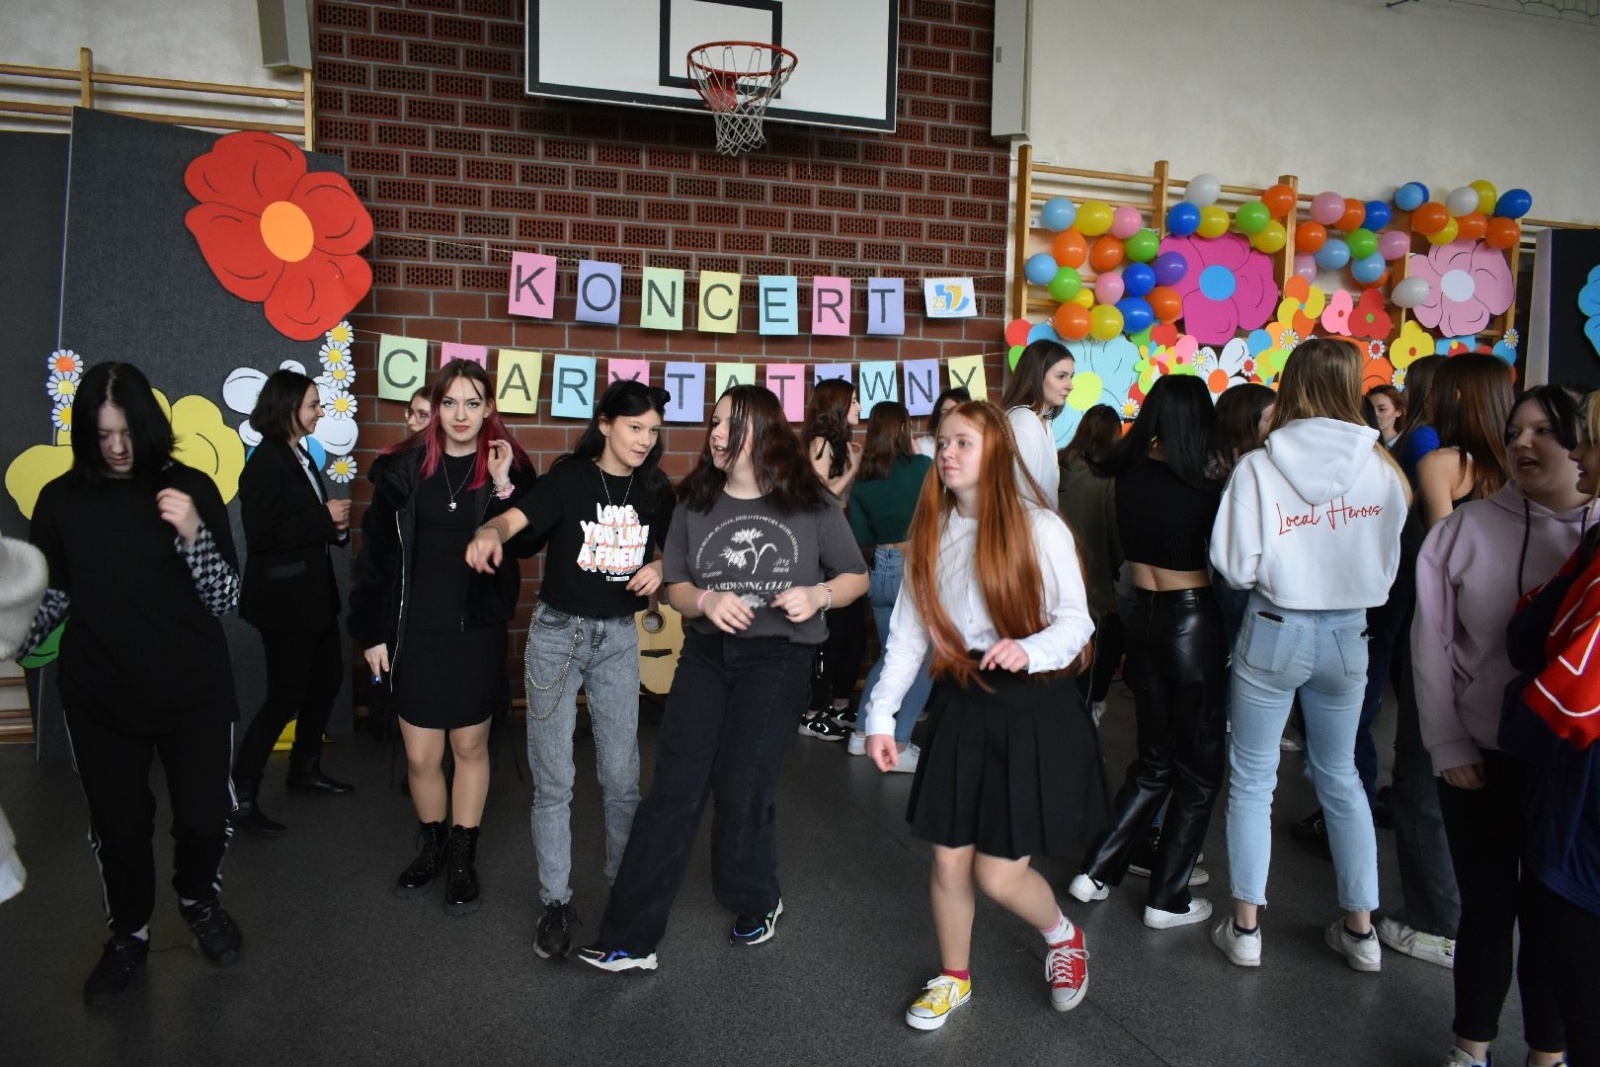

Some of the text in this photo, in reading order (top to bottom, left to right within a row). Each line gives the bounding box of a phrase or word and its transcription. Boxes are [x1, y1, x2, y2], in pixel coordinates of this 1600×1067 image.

[514, 264, 896, 324] KONCERT
[382, 348, 976, 410] CARTTWNY
[596, 502, 638, 526] LOVE
[1276, 495, 1383, 535] Local Heroes
[580, 520, 617, 547] YOU
[577, 543, 597, 572] A
